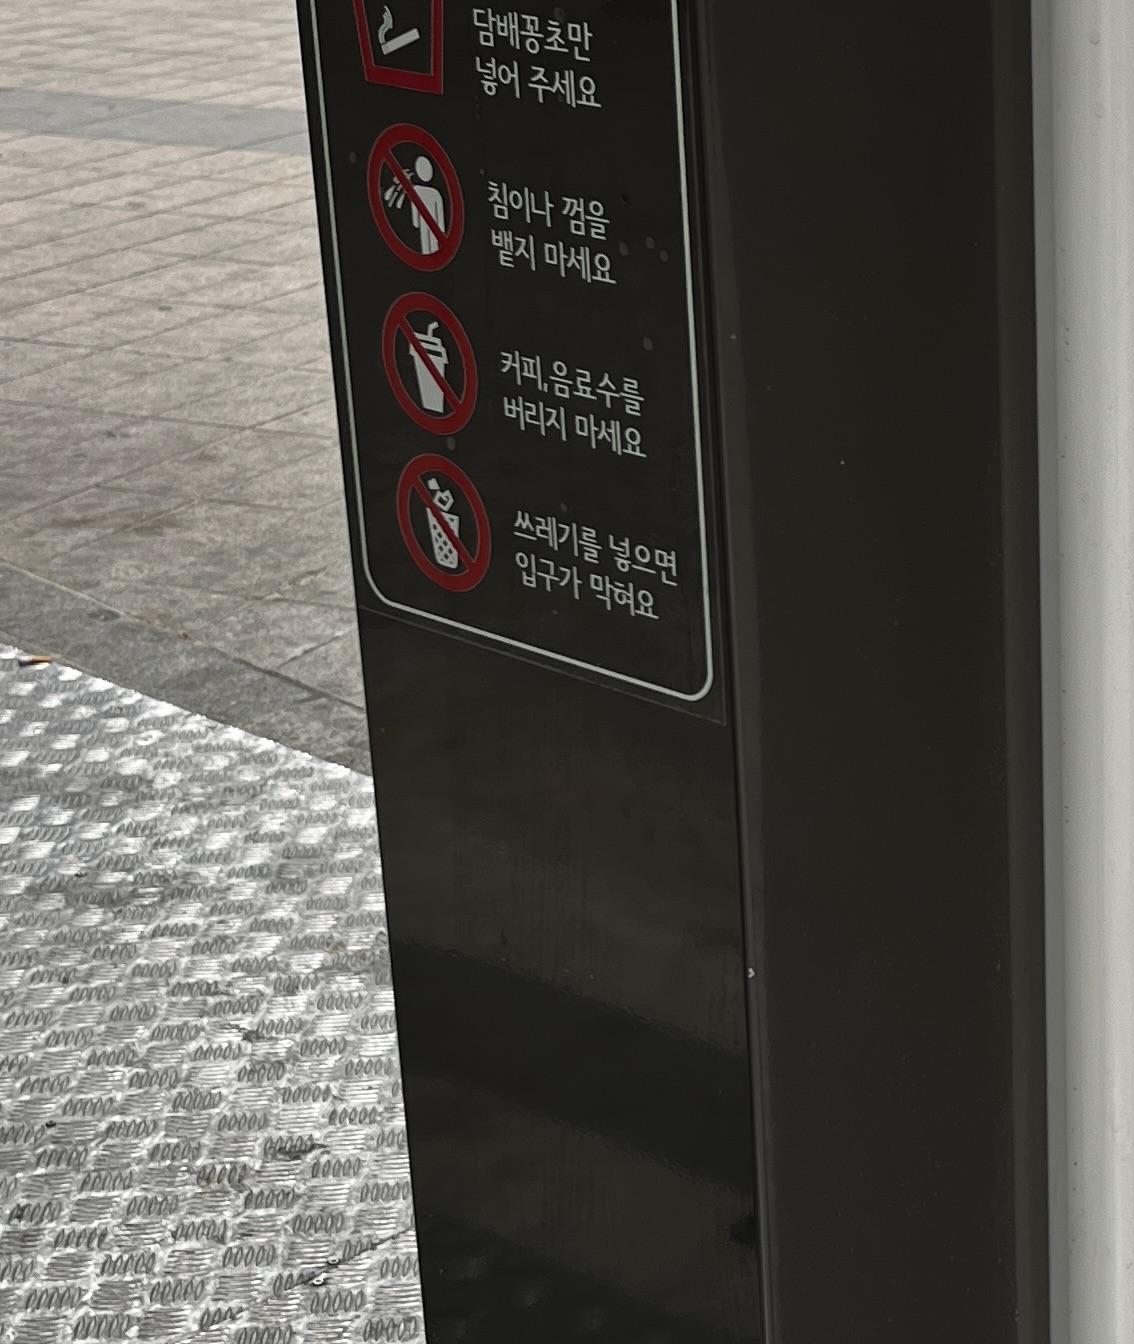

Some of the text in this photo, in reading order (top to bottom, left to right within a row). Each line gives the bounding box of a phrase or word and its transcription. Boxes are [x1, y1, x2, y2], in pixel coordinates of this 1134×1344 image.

[472, 7, 593, 62] 담배꽁초만
[475, 56, 602, 108] 넣어 주세요
[487, 180, 611, 241] 침이나 껌을
[490, 228, 617, 285] 뱉지 마세요
[500, 350, 645, 417] 커피,음료수를
[503, 395, 648, 458] 버리지 마세요
[513, 510, 679, 587] 쓰레기를 넣으면
[515, 551, 660, 620] 입구가 막혀요
